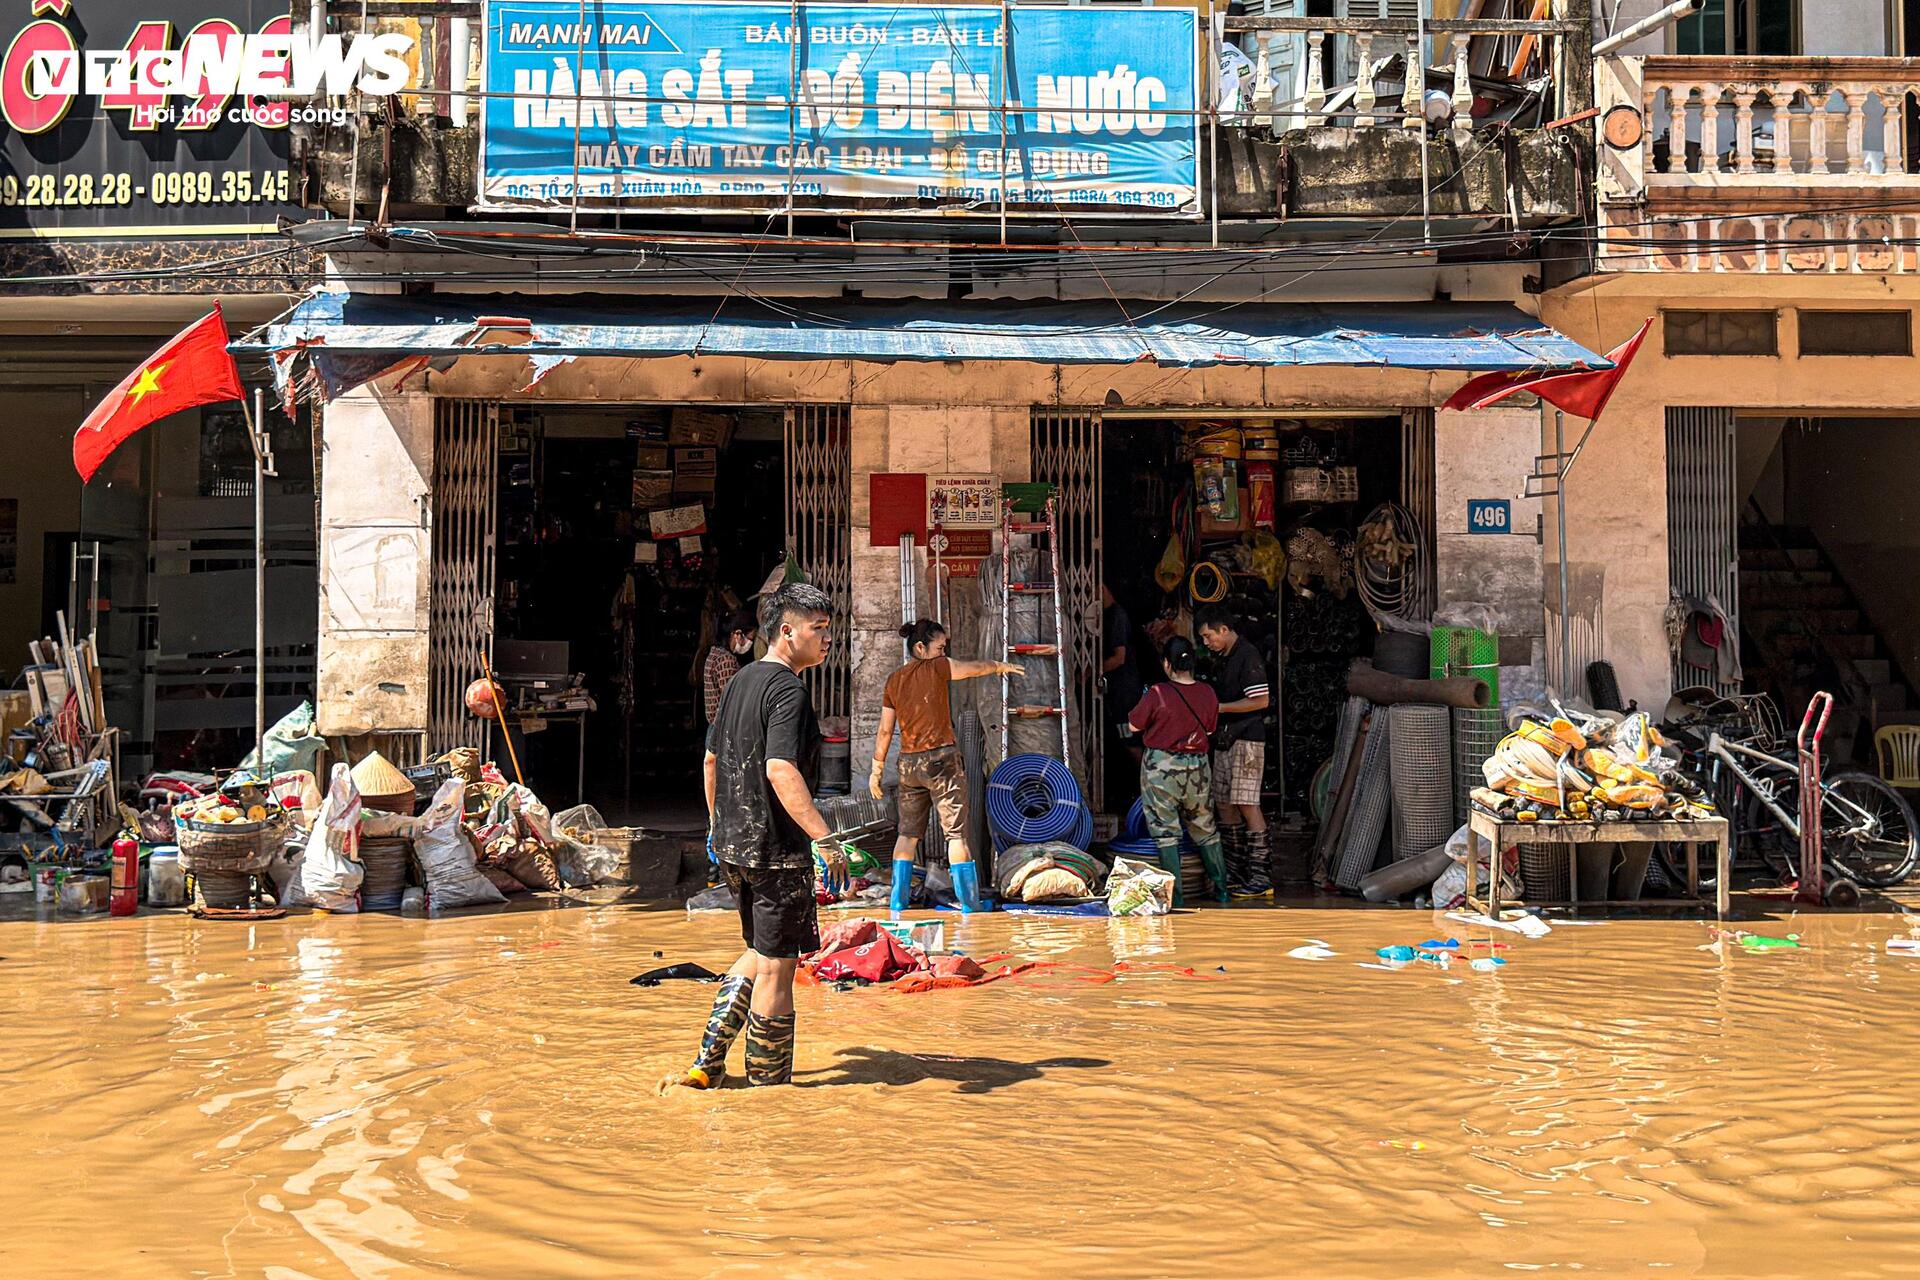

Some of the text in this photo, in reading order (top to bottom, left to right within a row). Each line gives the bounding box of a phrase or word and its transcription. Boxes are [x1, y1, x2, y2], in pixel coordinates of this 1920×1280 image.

[509, 23, 651, 48] MẠNH MAI
[744, 22, 801, 44] BÁN
[811, 23, 887, 45] BUÔN
[912, 25, 967, 46] BÁN
[513, 57, 647, 128] HÀNG
[661, 49, 754, 129] SẮT
[876, 61, 989, 143] ĐIỆN
[1037, 64, 1167, 137] NƯỚC
[579, 141, 639, 168] MÁY
[720, 143, 766, 168] TAY
[775, 141, 831, 169] CÁC
[841, 147, 904, 174] LOẠI
[977, 149, 1023, 173] GIA
[1032, 151, 1110, 178] DỤNG
[0, 173, 131, 206] 9.28.28.28
[151, 170, 288, 204] 0989.35.45
[1147, 191, 1176, 206] 393
[1473, 506, 1506, 527] 496
